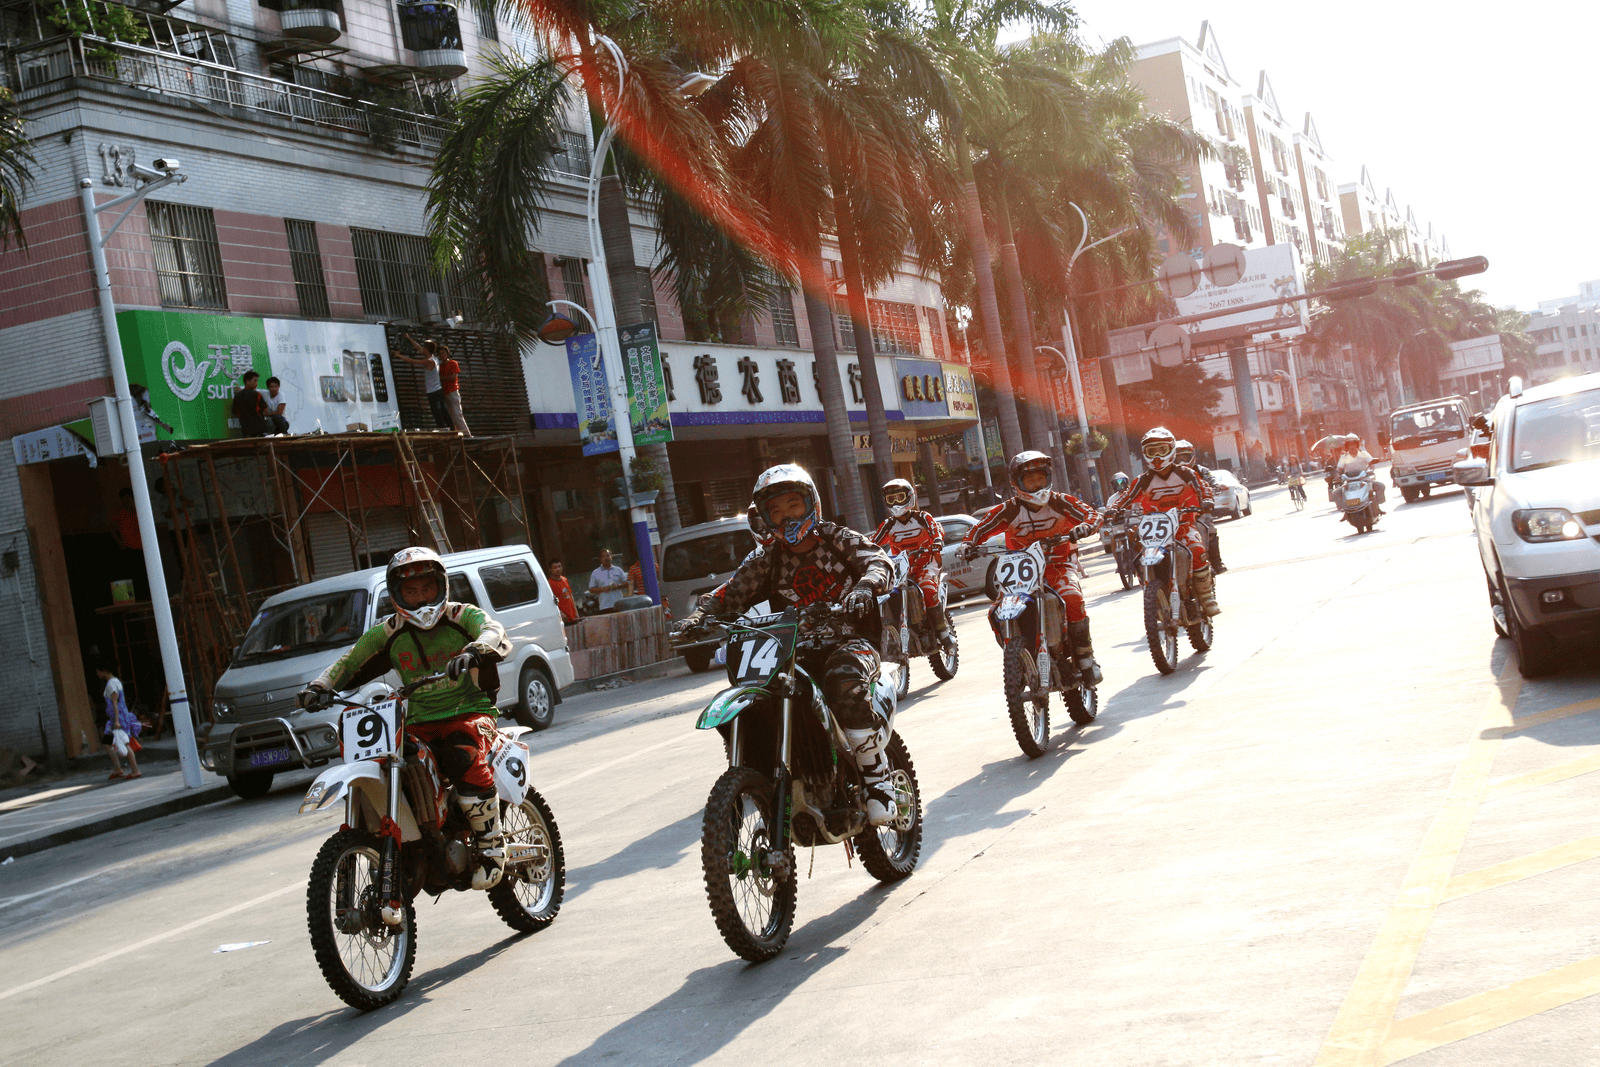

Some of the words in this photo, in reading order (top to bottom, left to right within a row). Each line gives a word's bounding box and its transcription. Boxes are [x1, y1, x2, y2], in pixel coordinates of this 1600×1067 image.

[1209, 301, 1226, 310] 2667
[1227, 297, 1244, 307] 1888
[207, 344, 253, 379] 天翼
[661, 352, 866, 405] 德农商行
[1420, 438, 1438, 446] JMC
[1141, 520, 1169, 540] 25
[1000, 558, 1034, 587] 26
[736, 638, 779, 680] 14
[357, 714, 383, 748] 9
[505, 757, 527, 787] 9
